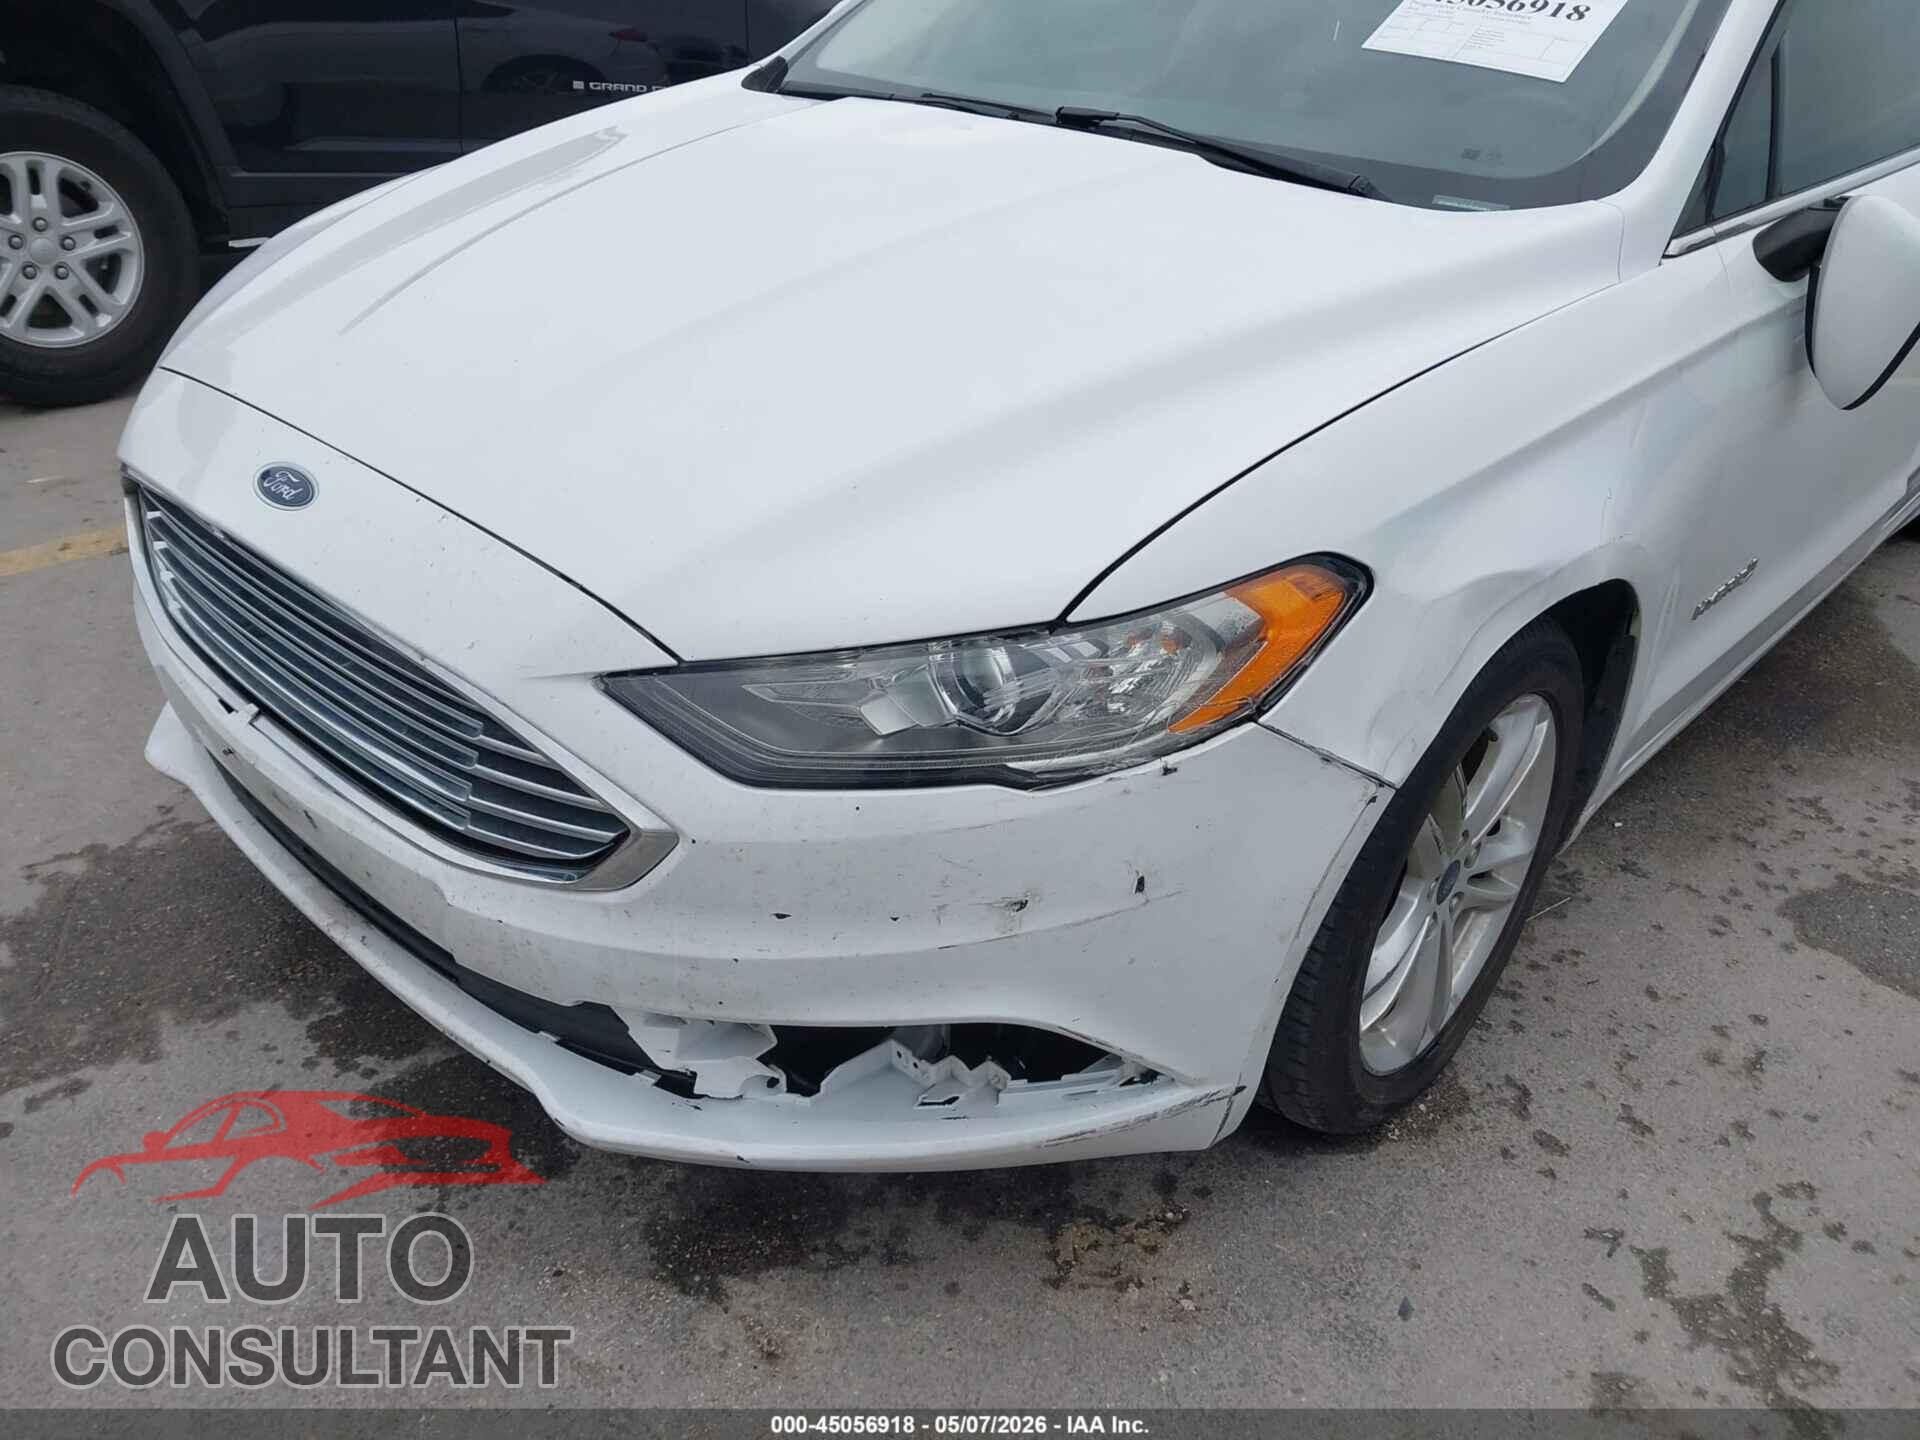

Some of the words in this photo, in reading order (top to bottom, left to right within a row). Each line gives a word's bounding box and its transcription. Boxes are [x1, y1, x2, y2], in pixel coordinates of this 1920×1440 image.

[1435, 0, 1592, 22] 56918
[588, 81, 648, 93] GRAND
[263, 470, 304, 500] Ford
